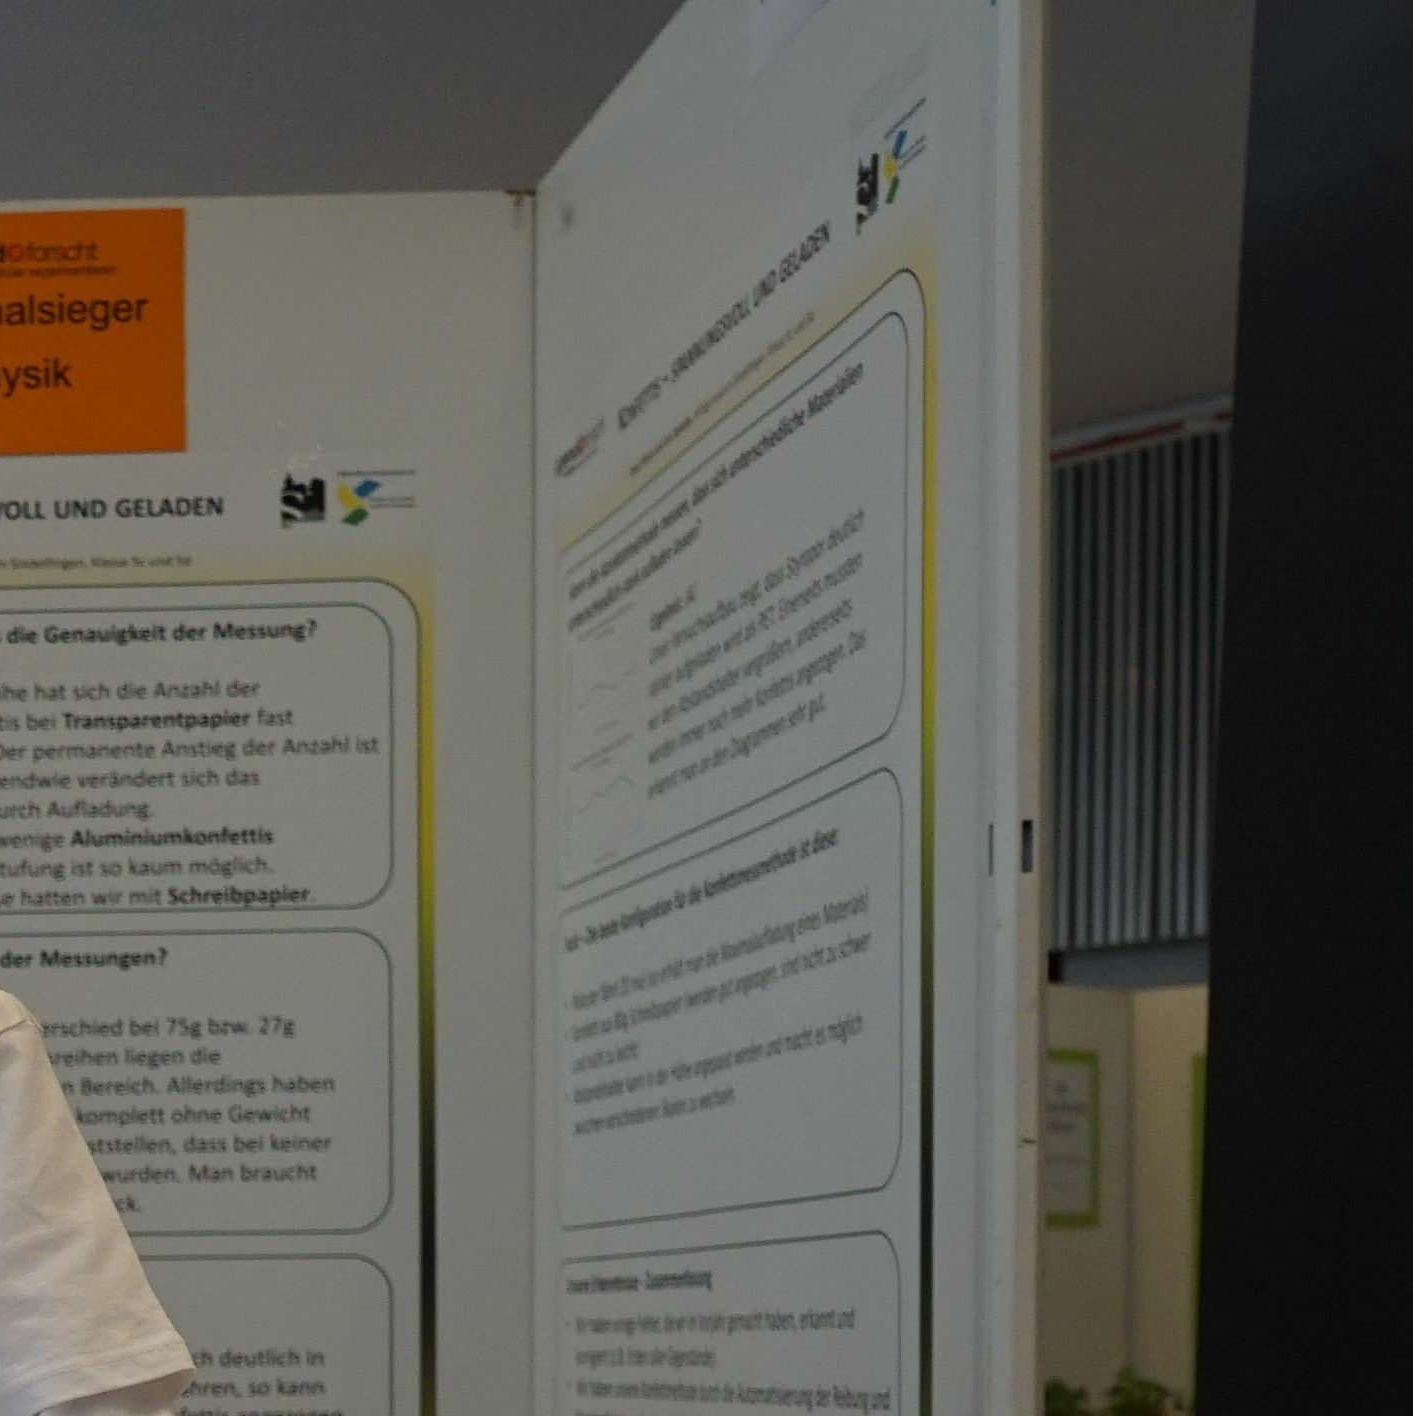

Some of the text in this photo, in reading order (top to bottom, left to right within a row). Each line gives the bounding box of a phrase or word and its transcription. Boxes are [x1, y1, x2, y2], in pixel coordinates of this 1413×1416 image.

[55, 499, 105, 519] UND
[115, 497, 222, 518] GELADEN
[7, 627, 37, 644] die
[174, 624, 205, 641] der
[213, 619, 317, 642] Messung?
